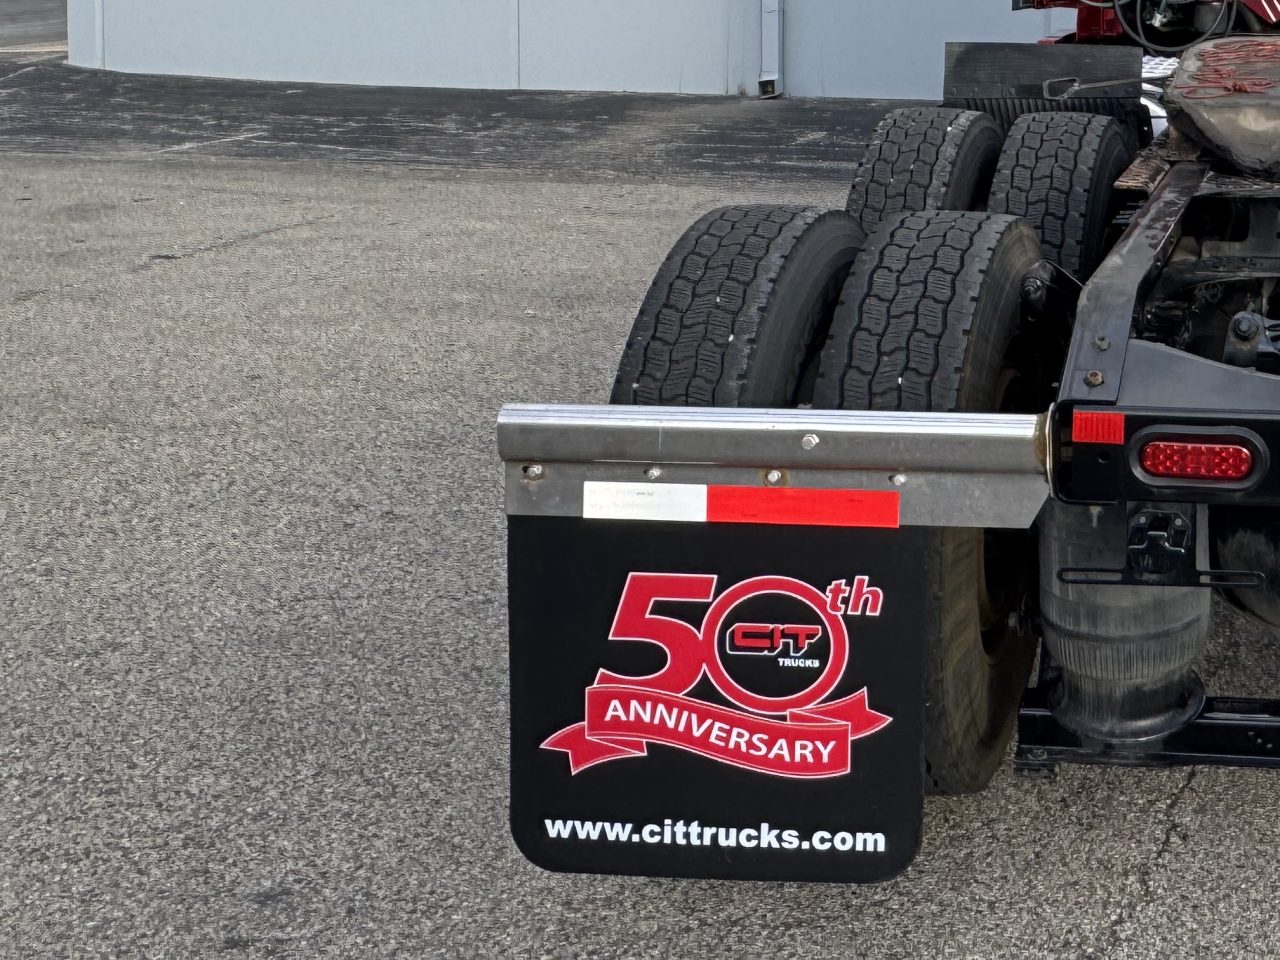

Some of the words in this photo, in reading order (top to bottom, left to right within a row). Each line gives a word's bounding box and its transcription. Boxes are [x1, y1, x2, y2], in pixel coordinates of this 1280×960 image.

[727, 623, 823, 655] CIT
[777, 657, 820, 668] TRUCKS
[604, 698, 837, 764] ANNIVERSARY
[544, 817, 887, 853] www.cittrucks.com
